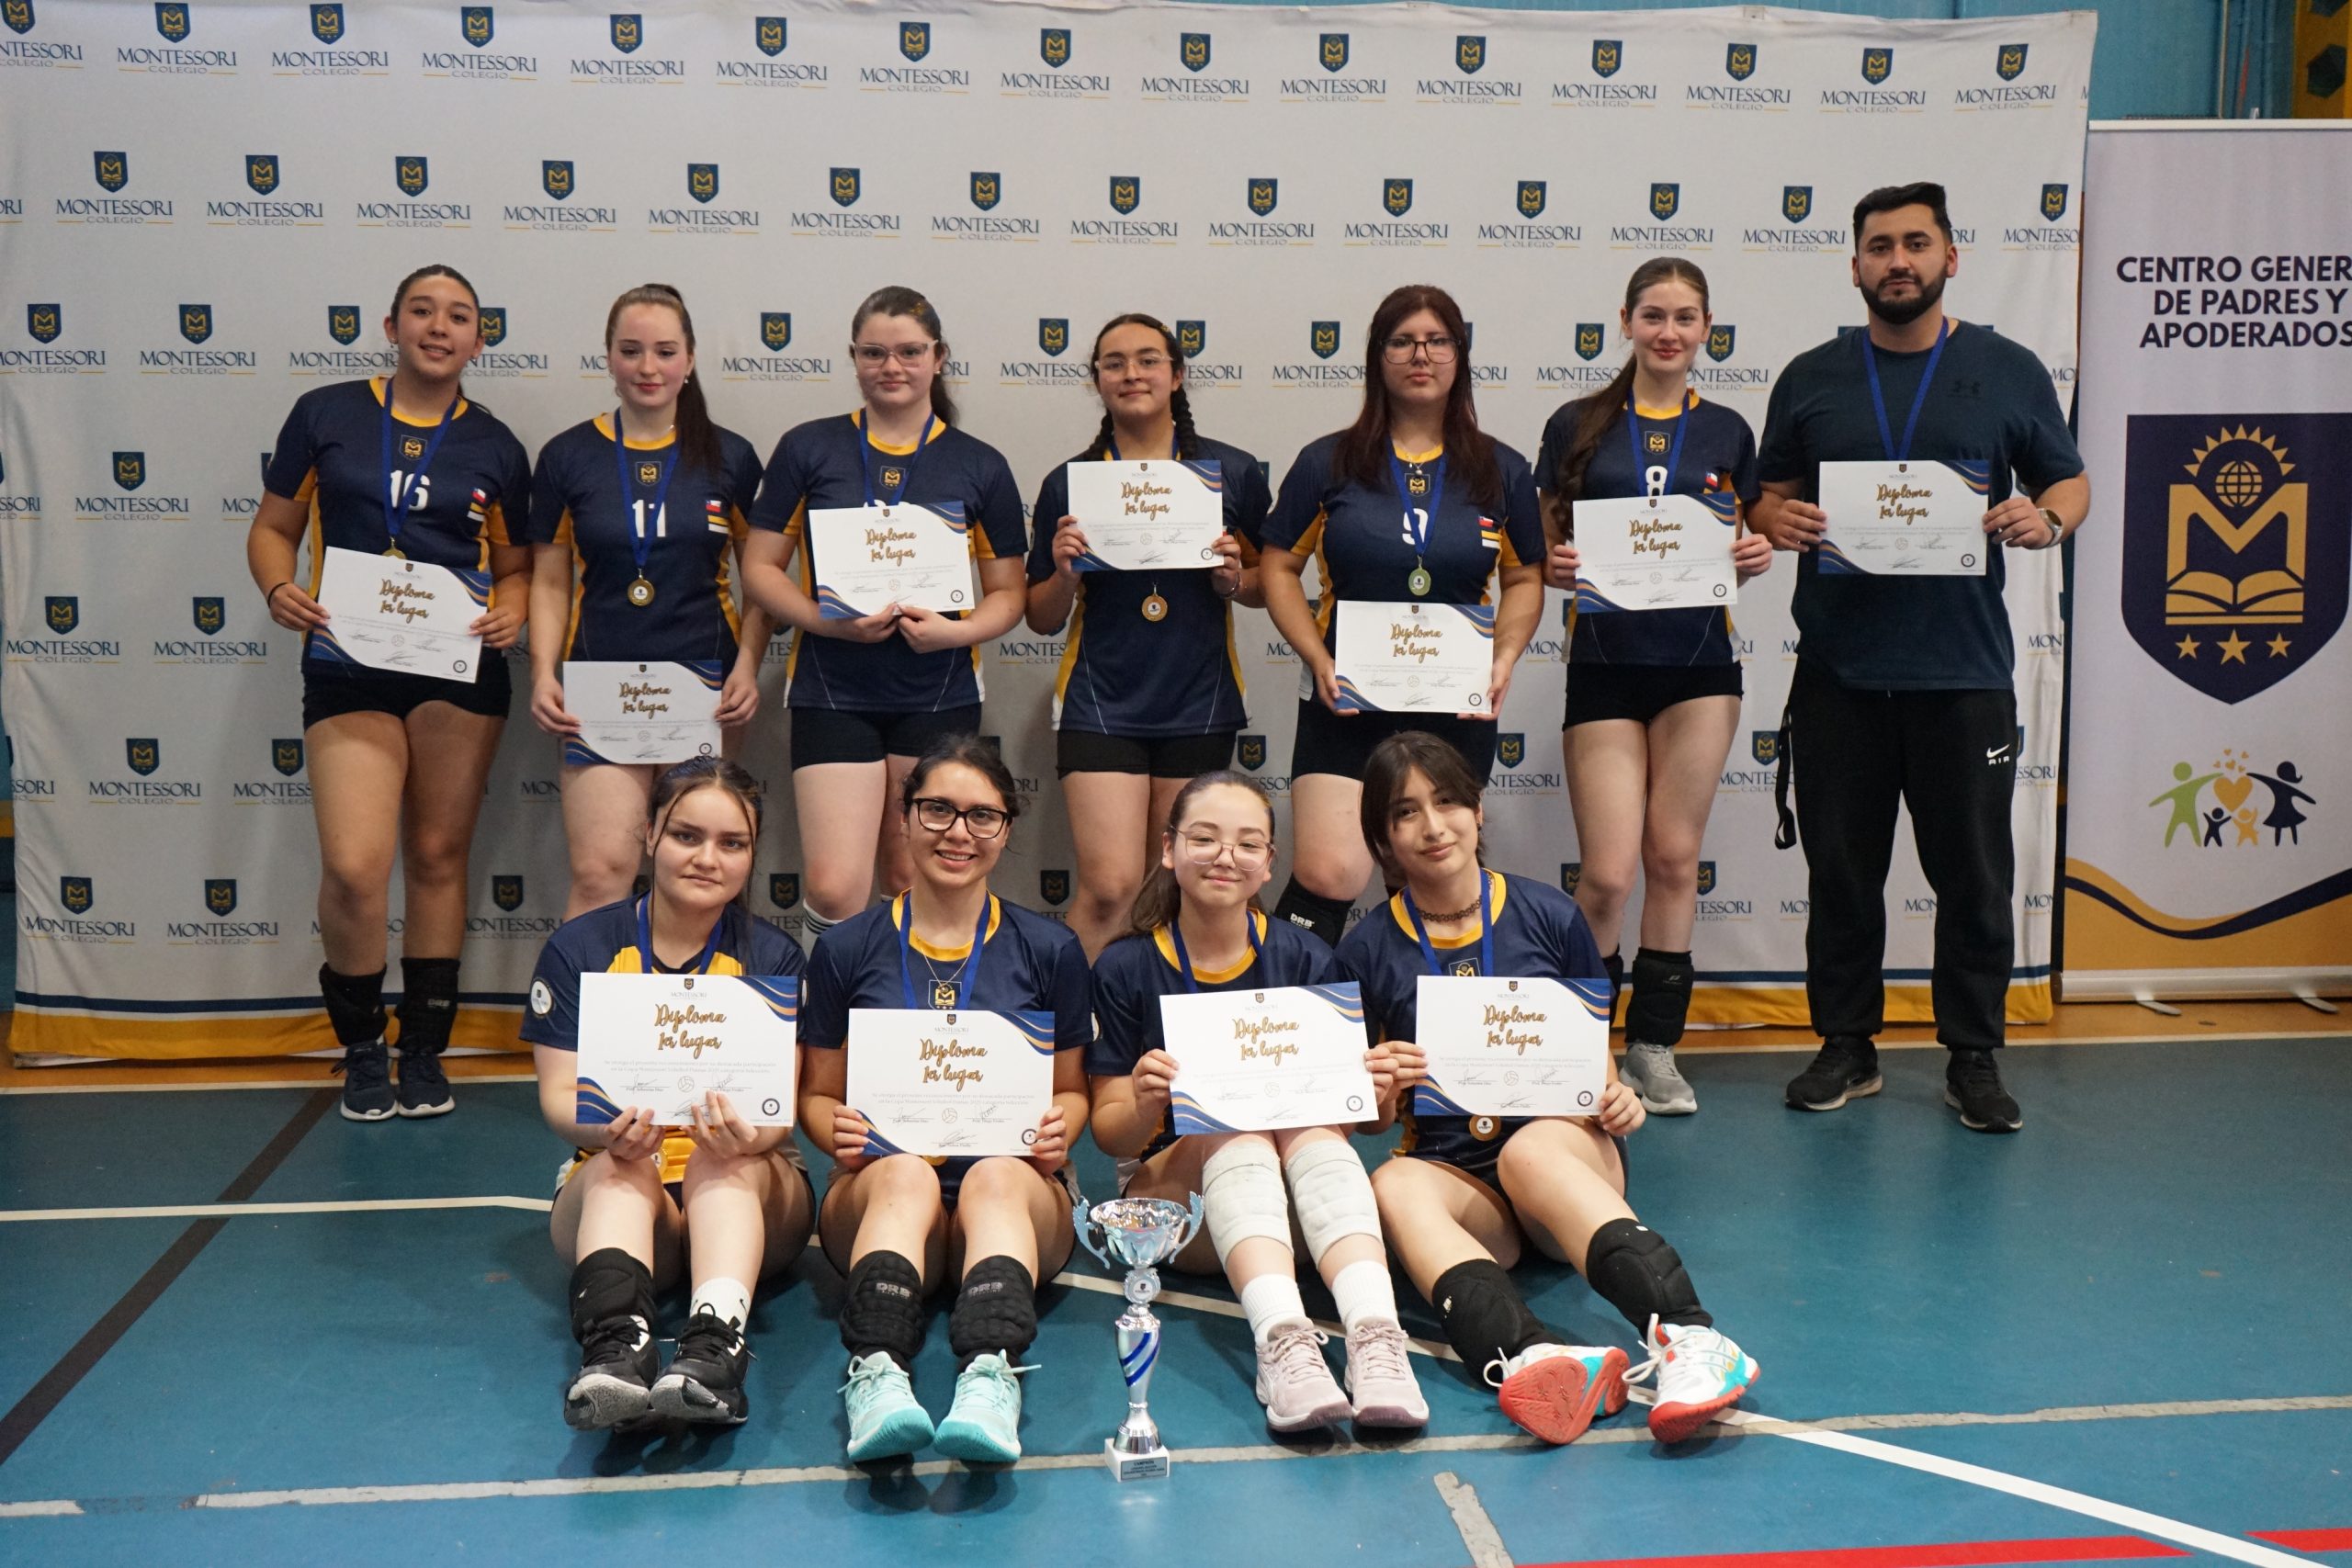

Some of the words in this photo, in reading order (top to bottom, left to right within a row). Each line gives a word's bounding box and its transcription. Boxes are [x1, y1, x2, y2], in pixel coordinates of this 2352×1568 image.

[0, 41, 83, 61] NTESSORI
[118, 48, 237, 67] MONTESSORI
[272, 51, 389, 69] MONTESSORI
[422, 52, 537, 72] MONTESSORI
[571, 60, 684, 76] MONTESSORI
[149, 65, 208, 74] COLEGIO
[302, 68, 360, 76] COLEGIO
[451, 71, 508, 79] COLEGIO
[717, 62, 828, 81] MONTESSORI
[860, 68, 969, 86] MONTESSORI
[600, 76, 656, 85] COLEGIO
[745, 79, 799, 88] COLEGIO
[888, 85, 942, 93] COLEGIO
[1001, 73, 1110, 91] MONTESSORI
[1141, 77, 1249, 95] MONTESSORI
[1281, 79, 1386, 95] MONTESSORI
[1417, 80, 1521, 96] MONTESSORI
[1028, 90, 1081, 98] COLEGIO
[1168, 94, 1222, 102] COLEGIO
[1552, 84, 1657, 100] MONTESSORI
[1687, 85, 1791, 104] MONTESSORI
[1821, 90, 1926, 106] MONTESSORI
[1954, 85, 2057, 104] MONTESSORI
[1712, 102, 1763, 111] COLEGIO
[1846, 106, 1897, 114] COLEGIO
[1979, 102, 2029, 111] COLEGIO
[56, 199, 173, 216] MONTESSORI
[207, 201, 323, 219] MONTESSORI
[357, 203, 470, 220] MONTESSORI
[503, 206, 616, 223] MONTESSORI
[86, 216, 143, 224] COLEGIO
[386, 220, 443, 228] COLEGIO
[649, 209, 760, 226] MONTESSORI
[791, 213, 900, 230] MONTESSORI
[932, 216, 1040, 233] MONTESSORI
[533, 222, 589, 231] COLEGIO
[819, 229, 873, 237] COLEGIO
[1071, 220, 1178, 237] MONTESSORI
[1208, 223, 1315, 239] MONTESSORI
[1345, 223, 1449, 239] MONTESSORI
[1478, 224, 1581, 241] MONTESSORI
[1611, 227, 1713, 243] MONTESSORI
[958, 232, 1012, 242] COLEGIO
[1097, 236, 1150, 244] COLEGIO
[1235, 238, 1286, 246] COLEGIO
[1370, 238, 1421, 246] COLEGIO
[1503, 241, 1555, 249] COLEGIO
[1743, 229, 1846, 245] MONTESSORI
[2004, 228, 2079, 245] MONTESSO
[1635, 243, 1687, 251] COLEGIO
[2117, 255, 2243, 283] CENTRO
[2154, 289, 2191, 315] DE
[2201, 288, 2319, 315] PADRES
[2325, 288, 2348, 314] Y
[2139, 321, 2352, 348] APODERADOS
[0, 350, 106, 367] ONTESSORI
[140, 351, 256, 367] MONTESSORI
[289, 351, 396, 368] MONTESSOR
[469, 353, 548, 370] NTESSORI
[723, 356, 831, 373] MONTESSORI
[18, 367, 77, 375] COLEGIO
[1000, 362, 1092, 378] MONTESSO
[1187, 365, 1242, 380] ESSORI
[1272, 365, 1367, 380] MONTESSOR
[1686, 367, 1769, 383] ONTESSORI
[1645, 465, 1668, 496] 8
[390, 469, 431, 511] 16
[1120, 481, 1172, 502] Diploma
[1876, 483, 1933, 506] Diploma
[75, 497, 189, 513] MONTESSORI
[1139, 500, 1170, 521] lugar
[104, 513, 160, 522] COLEGIO
[1896, 503, 1929, 525] lugar
[1402, 508, 1429, 545] 9
[1629, 518, 1683, 541] Diploma
[865, 527, 917, 549] Diploma
[886, 546, 916, 567] lugar
[1649, 538, 1680, 559] lugar
[379, 579, 435, 603] Diploma
[397, 601, 429, 624] lugar
[1390, 623, 1443, 645] Diploma
[6, 639, 120, 656] MONTESSORI
[154, 641, 267, 657] MONTESSORI
[1000, 641, 1067, 657] MONTES
[1408, 642, 1440, 663] lugar
[183, 657, 238, 665] COLEGIO
[618, 682, 673, 702] Diploma
[638, 700, 669, 720] lugar
[1988, 756, 2009, 766] AIR
[88, 782, 201, 796] MONTESSORI
[1487, 773, 1561, 788] NTESSORI
[234, 782, 311, 797] MONTESS
[1694, 900, 1752, 914] TESSORI
[27, 917, 135, 936] MONTESSORI
[167, 922, 279, 938] MONTESSORI
[654, 1003, 727, 1033] Diploma
[1483, 1003, 1547, 1032] Diploma
[1232, 1016, 1299, 1043] Diploma
[680, 1030, 722, 1059] lugar
[1506, 1029, 1544, 1055] lugar
[919, 1038, 988, 1067] Diploma
[1260, 1040, 1299, 1066] lugar
[943, 1064, 983, 1092] lugar
